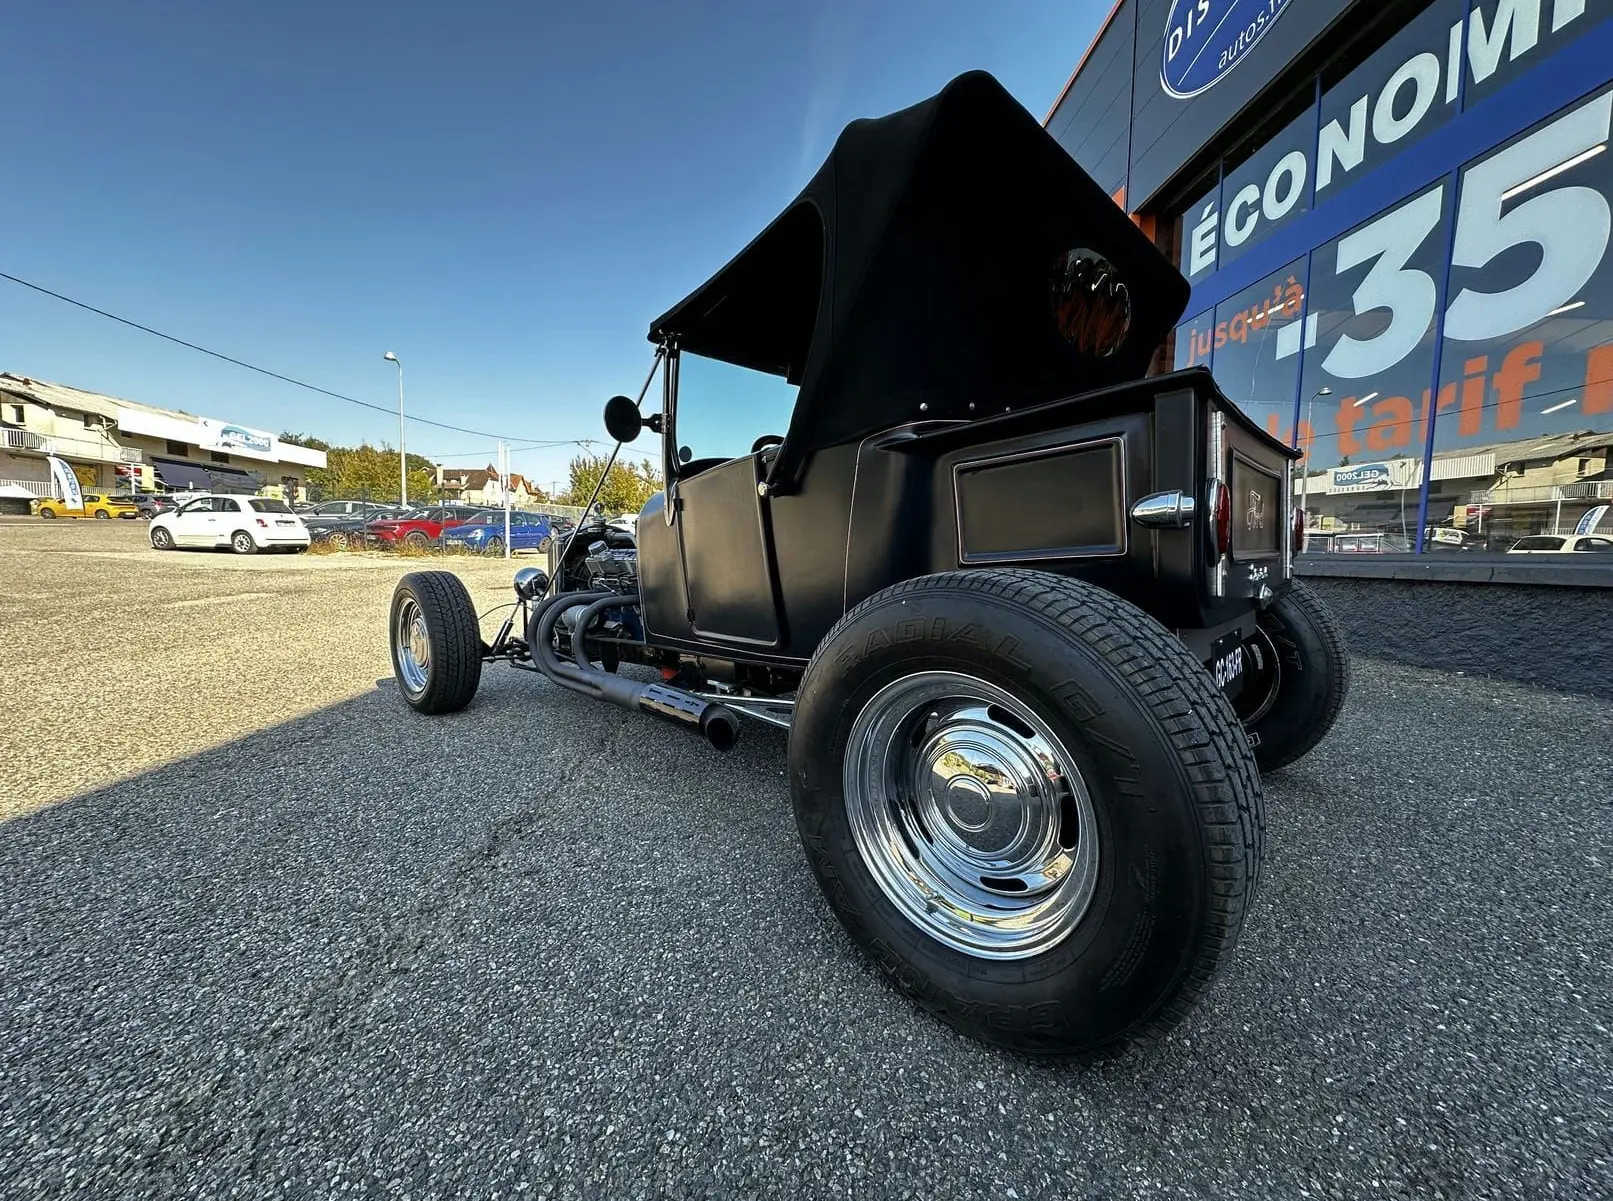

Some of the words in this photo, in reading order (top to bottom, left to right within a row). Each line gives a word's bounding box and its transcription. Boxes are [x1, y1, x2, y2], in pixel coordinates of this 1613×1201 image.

[1218, 0, 1282, 69] autos.
[1335, 340, 1544, 457] tarif
[835, 616, 1034, 676] RADIAL
